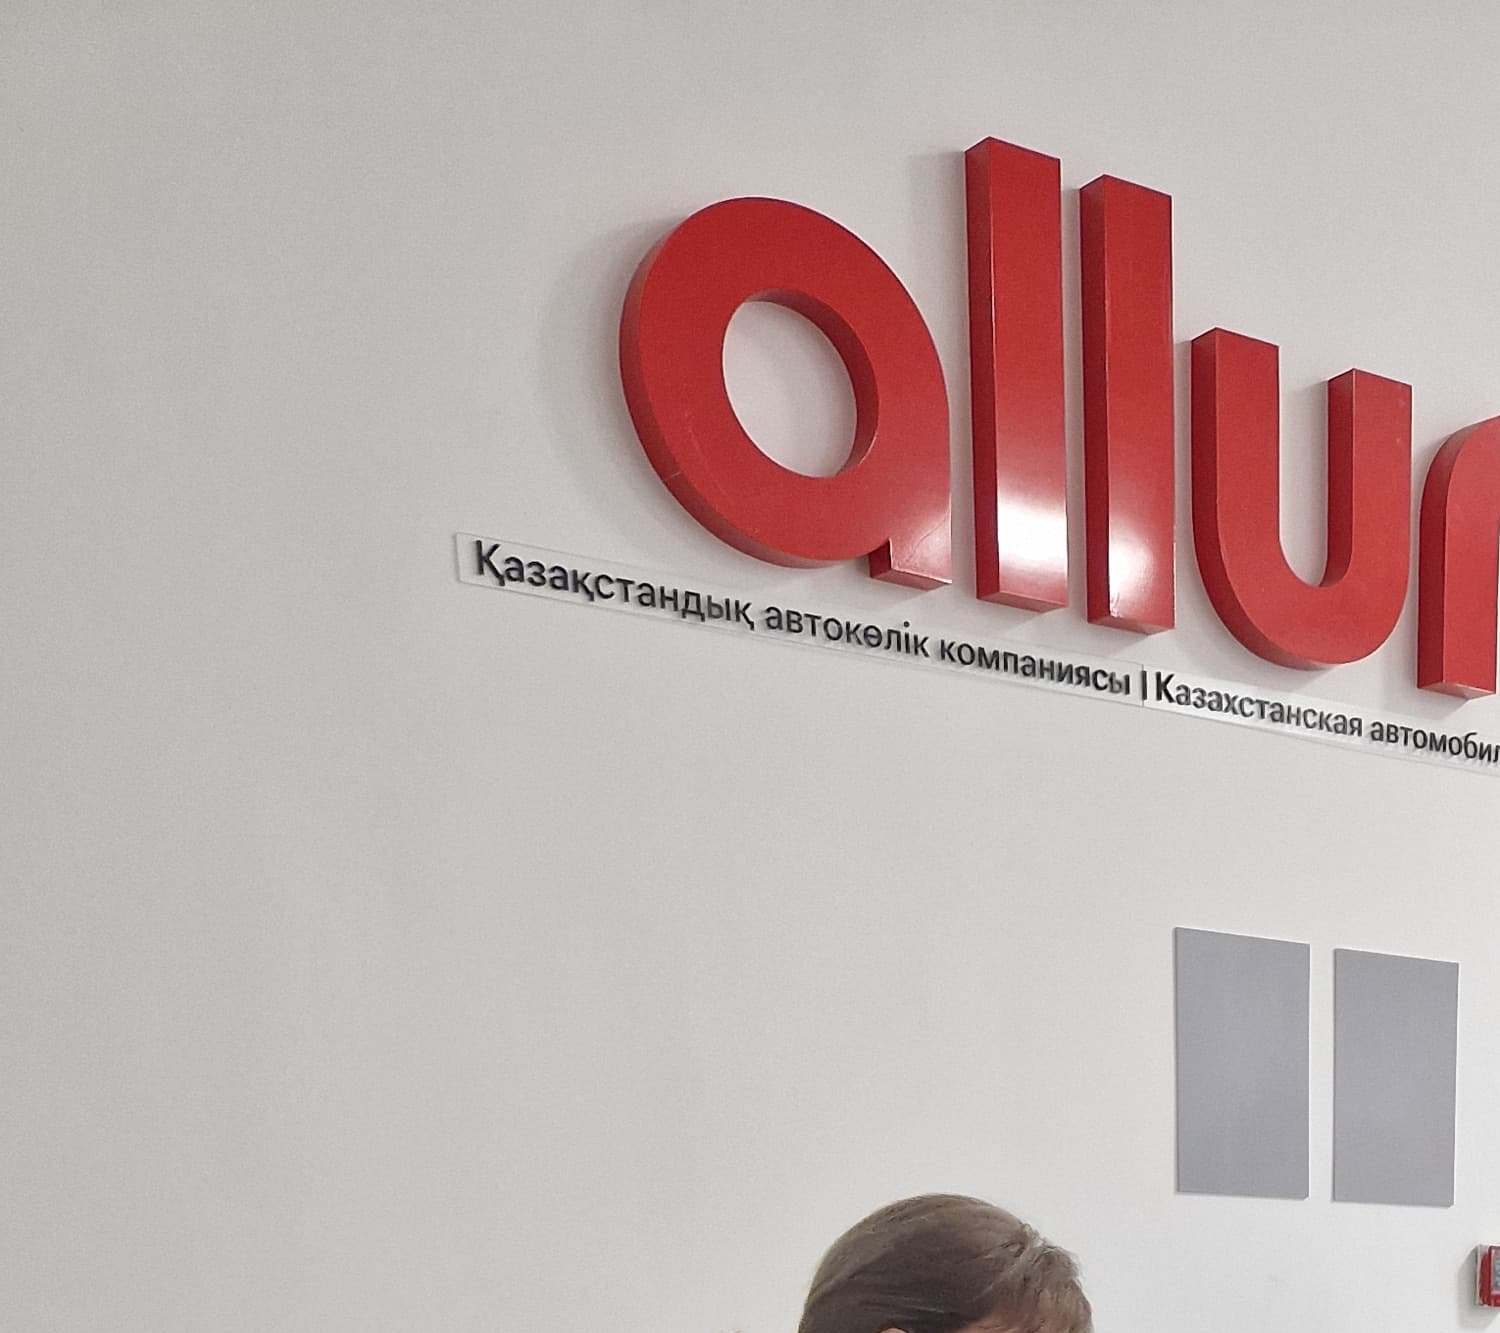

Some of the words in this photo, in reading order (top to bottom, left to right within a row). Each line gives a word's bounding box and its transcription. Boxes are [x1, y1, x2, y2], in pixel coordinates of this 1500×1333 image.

[475, 539, 755, 631] Қазақстандық
[764, 605, 930, 659] автокөлік
[940, 639, 1131, 696] компаниясы
[1155, 671, 1363, 737] Казахстанская
